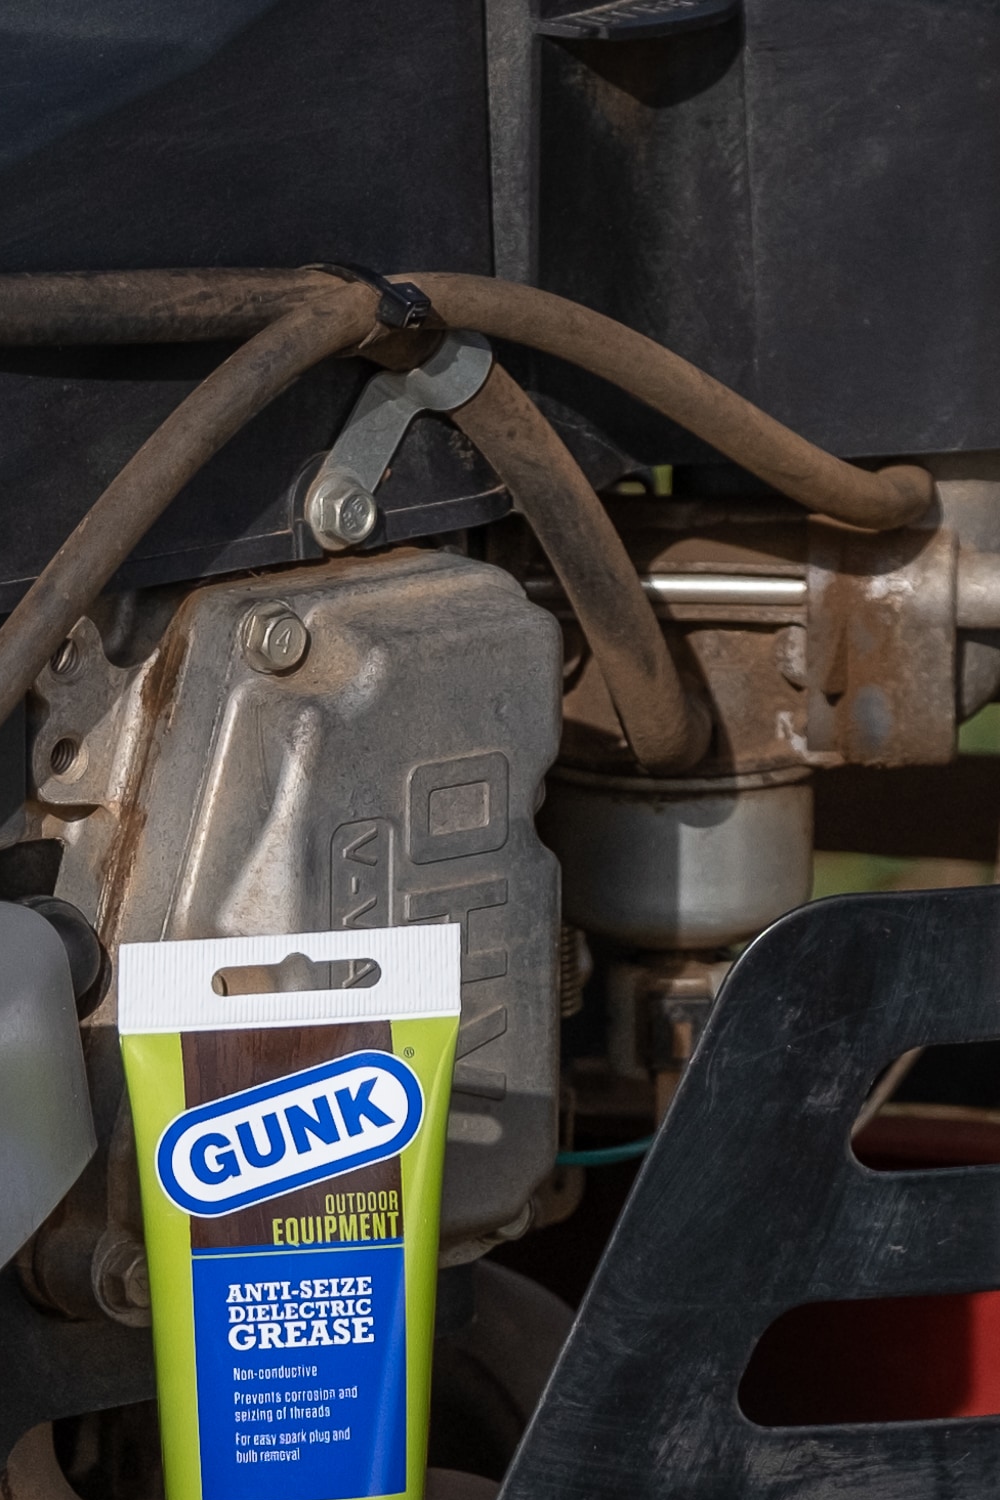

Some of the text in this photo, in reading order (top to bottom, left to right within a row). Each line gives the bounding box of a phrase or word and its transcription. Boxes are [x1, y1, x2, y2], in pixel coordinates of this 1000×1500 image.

[189, 1076, 395, 1185] GUNK
[326, 1191, 398, 1214] OUTDOOR
[273, 1212, 399, 1246] EQUIPMENT
[226, 1276, 372, 1303] ANTI-SEIZE
[228, 1299, 371, 1323] DIELECTRIC
[228, 1317, 374, 1351] GREASE
[234, 1365, 318, 1381] Non-conductive
[234, 1386, 358, 1404] Prevents corrosion and
[235, 1405, 330, 1422] seizing of threads
[236, 1427, 350, 1446] For easy spark plug and
[236, 1448, 300, 1463] bulb removal
